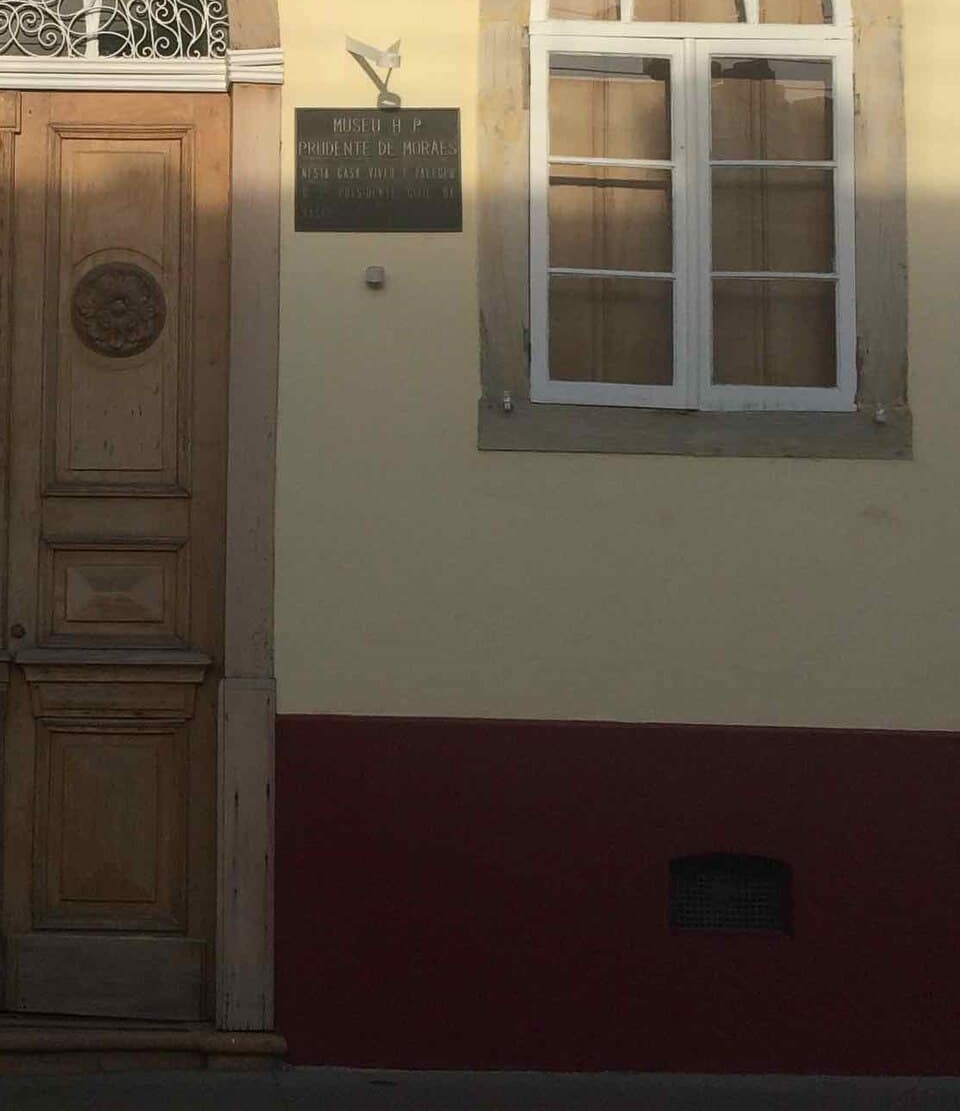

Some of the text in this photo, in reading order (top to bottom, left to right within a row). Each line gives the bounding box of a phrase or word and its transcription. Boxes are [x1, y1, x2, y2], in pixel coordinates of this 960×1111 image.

[333, 116, 423, 134] MUSEU H P
[297, 139, 458, 157] PRUDENTE DE MORAES
